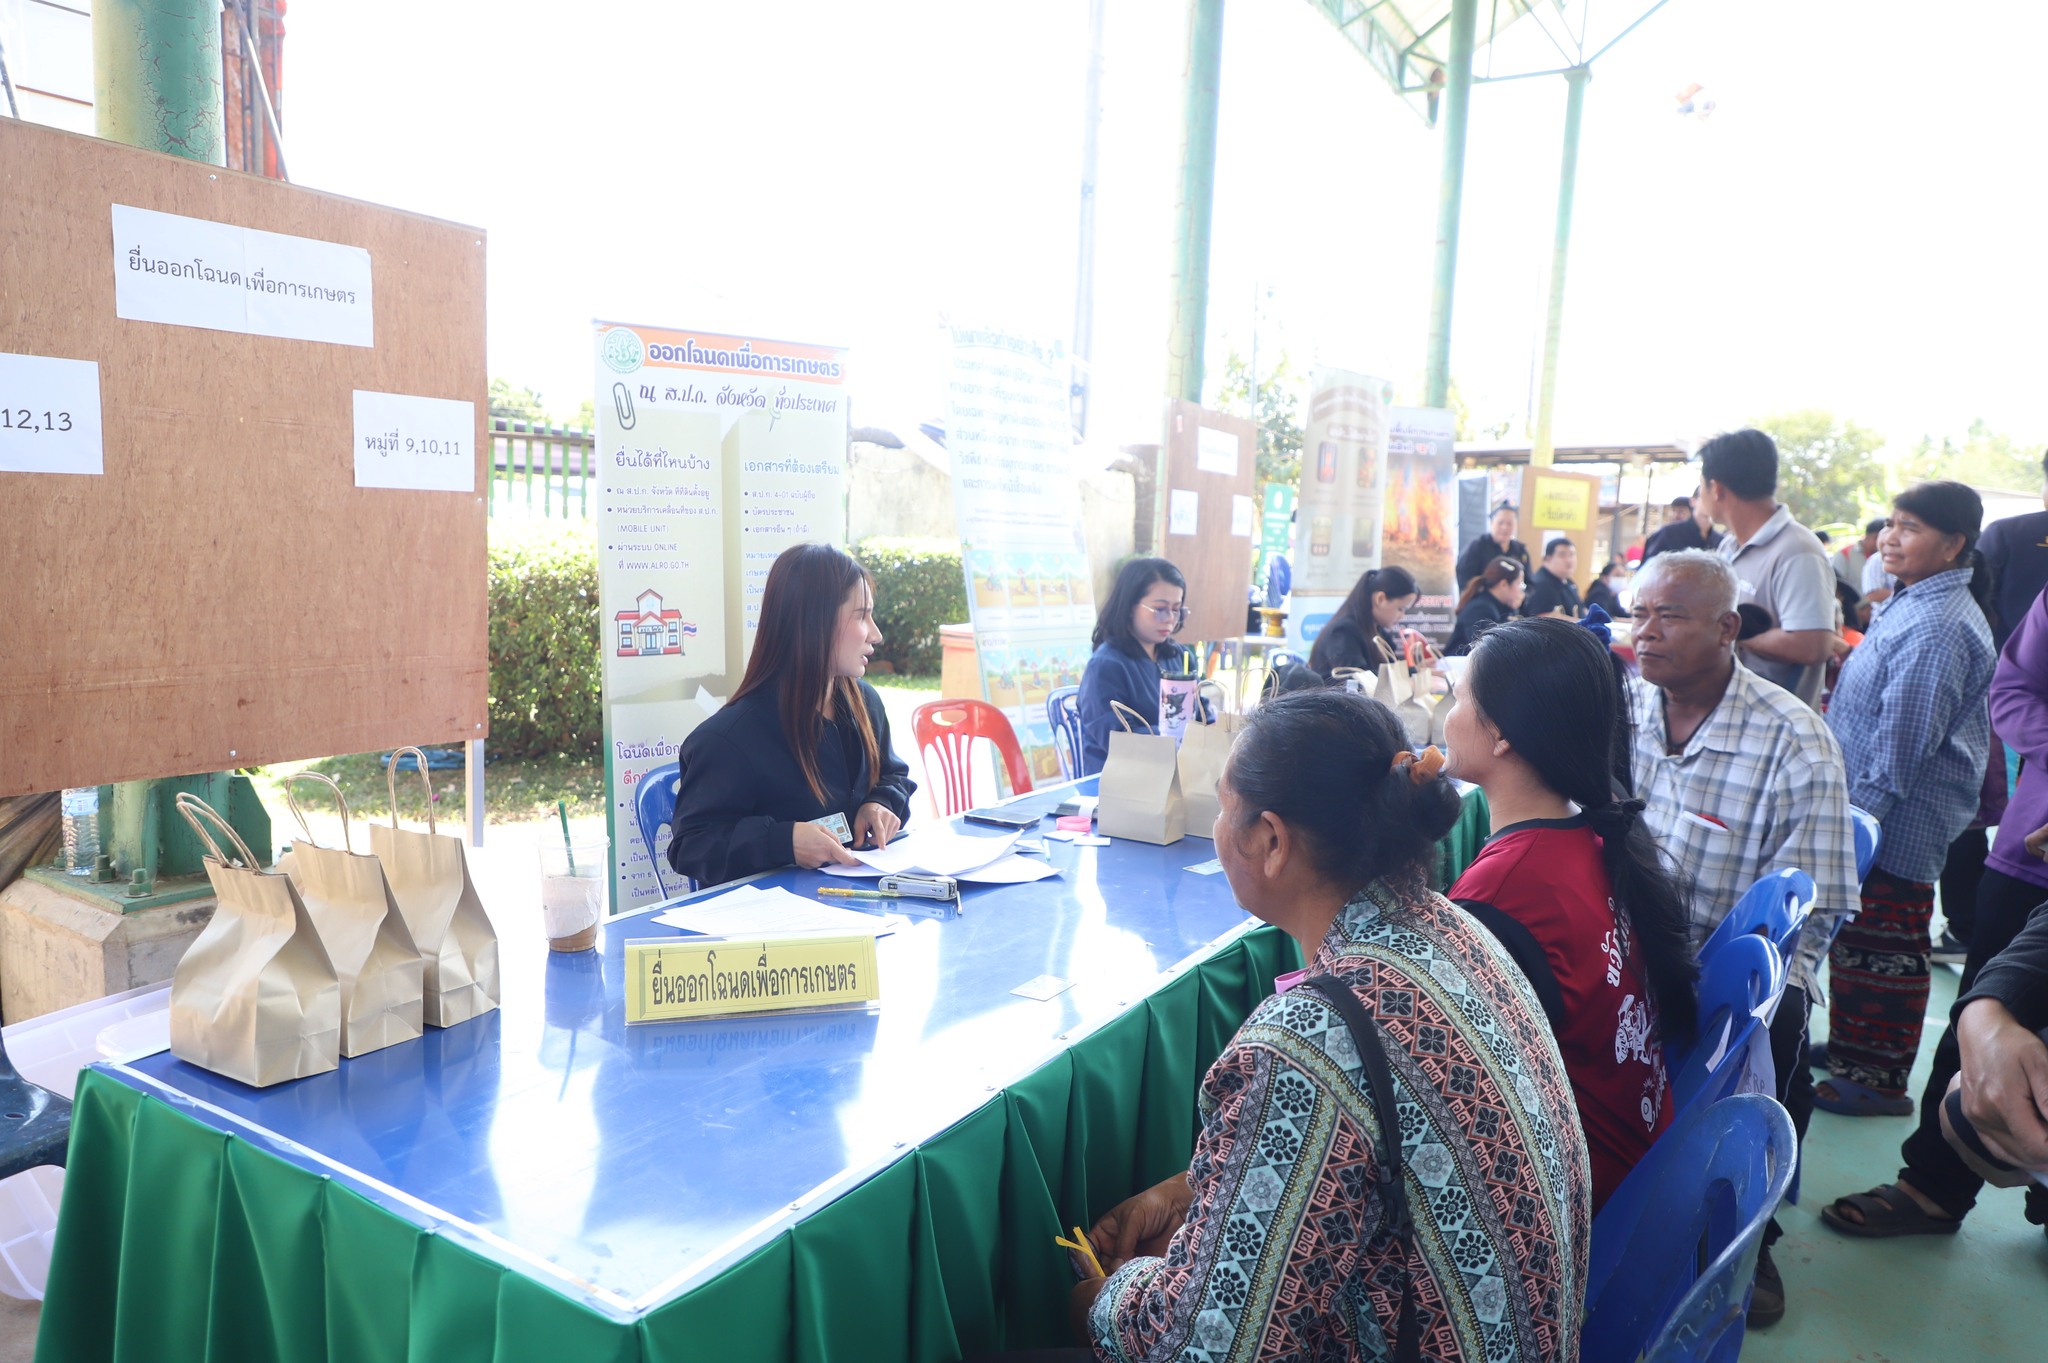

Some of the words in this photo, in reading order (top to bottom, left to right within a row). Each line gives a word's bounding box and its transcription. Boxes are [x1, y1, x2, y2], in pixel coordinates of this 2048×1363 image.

[649, 341, 841, 378] ออกโฉนดเพื่อการเกษตร
[665, 385, 707, 405] ส.ป.ก.
[716, 385, 766, 409] จังหวัด
[775, 386, 838, 413] ทั่วประเทศ
[1, 408, 73, 433] 12,13
[365, 428, 400, 458] หมู่ที่
[405, 436, 461, 457] 9,10,11
[615, 445, 711, 471] ยื่นได้ที่ไหนบ้าง
[744, 454, 839, 476] เอกสารที่ต้องเตรียม
[617, 524, 648, 533] (MOBILE
[650, 524, 669, 533] UNIT)
[654, 543, 678, 551] ONLINE
[652, 943, 857, 1005] ยื่นออกโฉนดเพื่อการเกษตร
